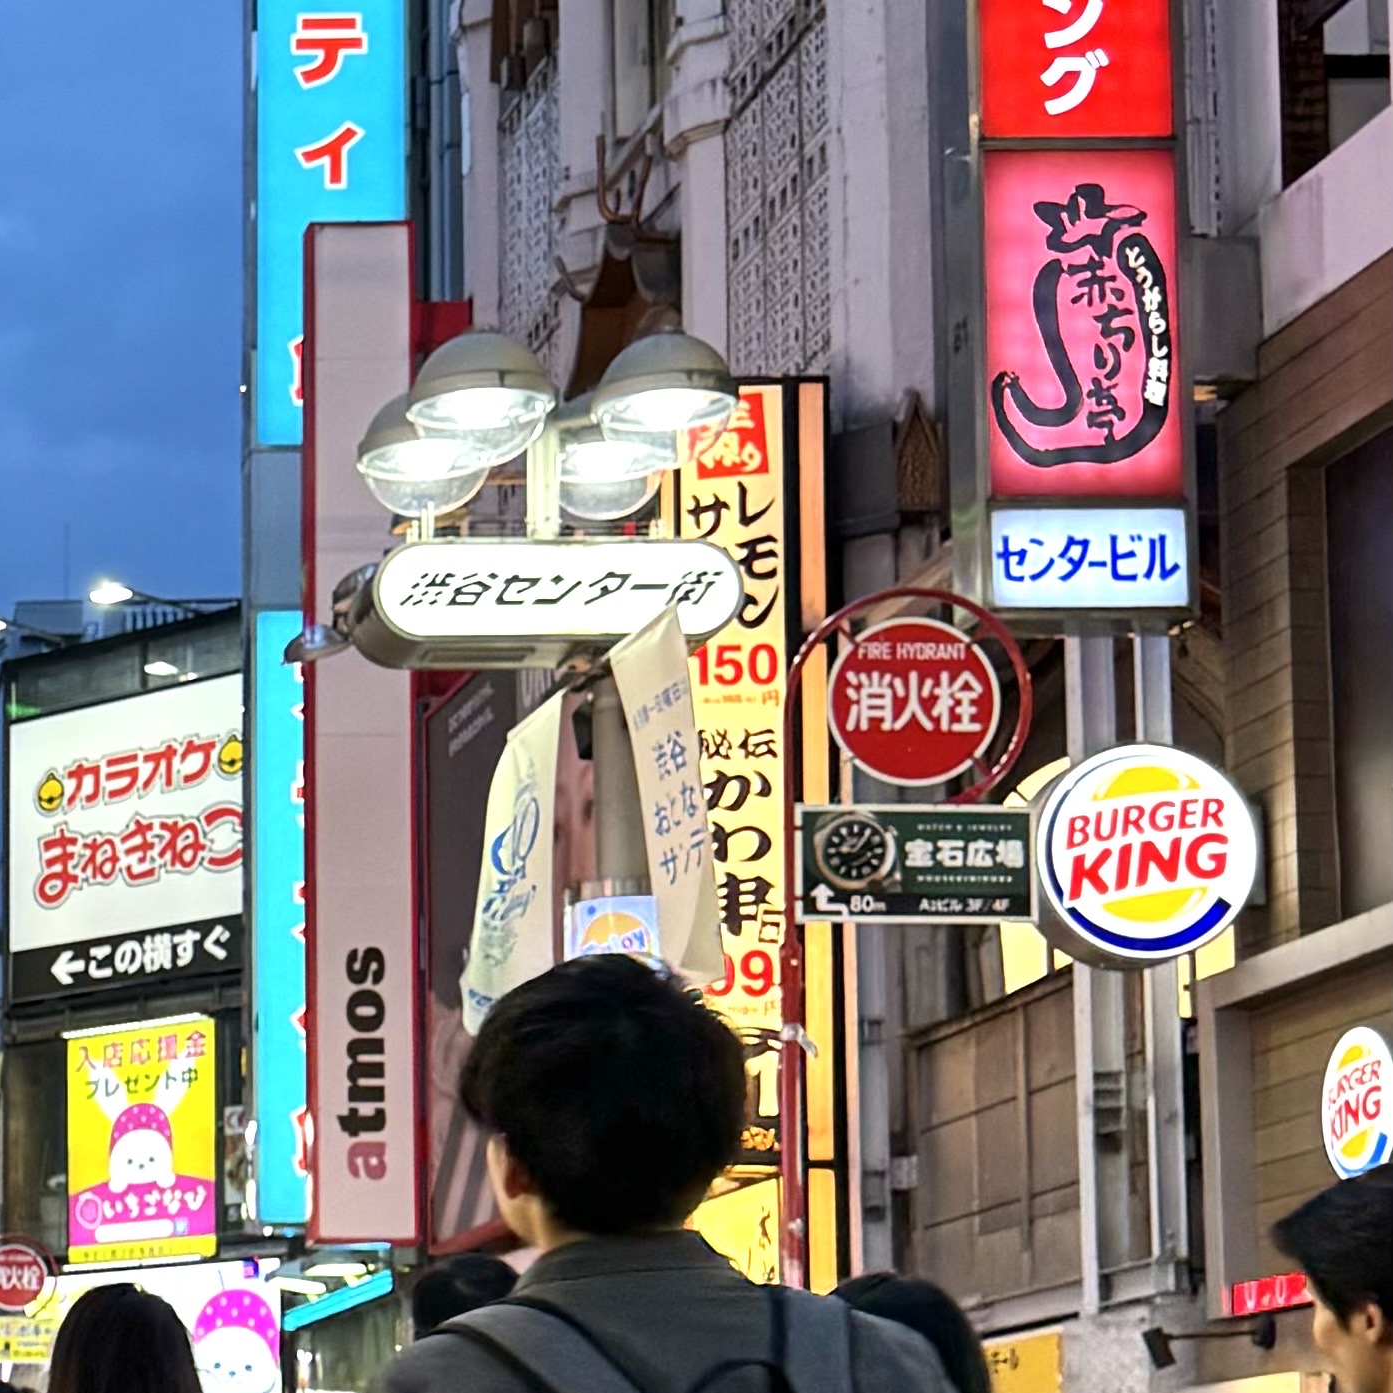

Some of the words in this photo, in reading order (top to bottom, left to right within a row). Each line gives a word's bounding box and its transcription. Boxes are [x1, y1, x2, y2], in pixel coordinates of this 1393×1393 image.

[996, 533, 1181, 585] センタービル
[400, 569, 723, 608] 渋谷センター街
[695, 642, 779, 687] 150
[858, 641, 892, 662] FIRE
[896, 641, 968, 662] HYDRANT
[845, 669, 985, 734] 消火栓
[65, 738, 217, 808] カラオケ
[1066, 797, 1226, 851] BURGER
[38, 806, 244, 907] まねきねこ
[904, 838, 1025, 869] 宝石広場
[1068, 834, 1230, 901] KING
[850, 895, 887, 913] 80m
[87, 924, 231, 980] この横すぐ
[76, 1029, 207, 1073] 入店応援金
[336, 945, 387, 1182] atmos
[85, 1066, 199, 1101] プレゼント中
